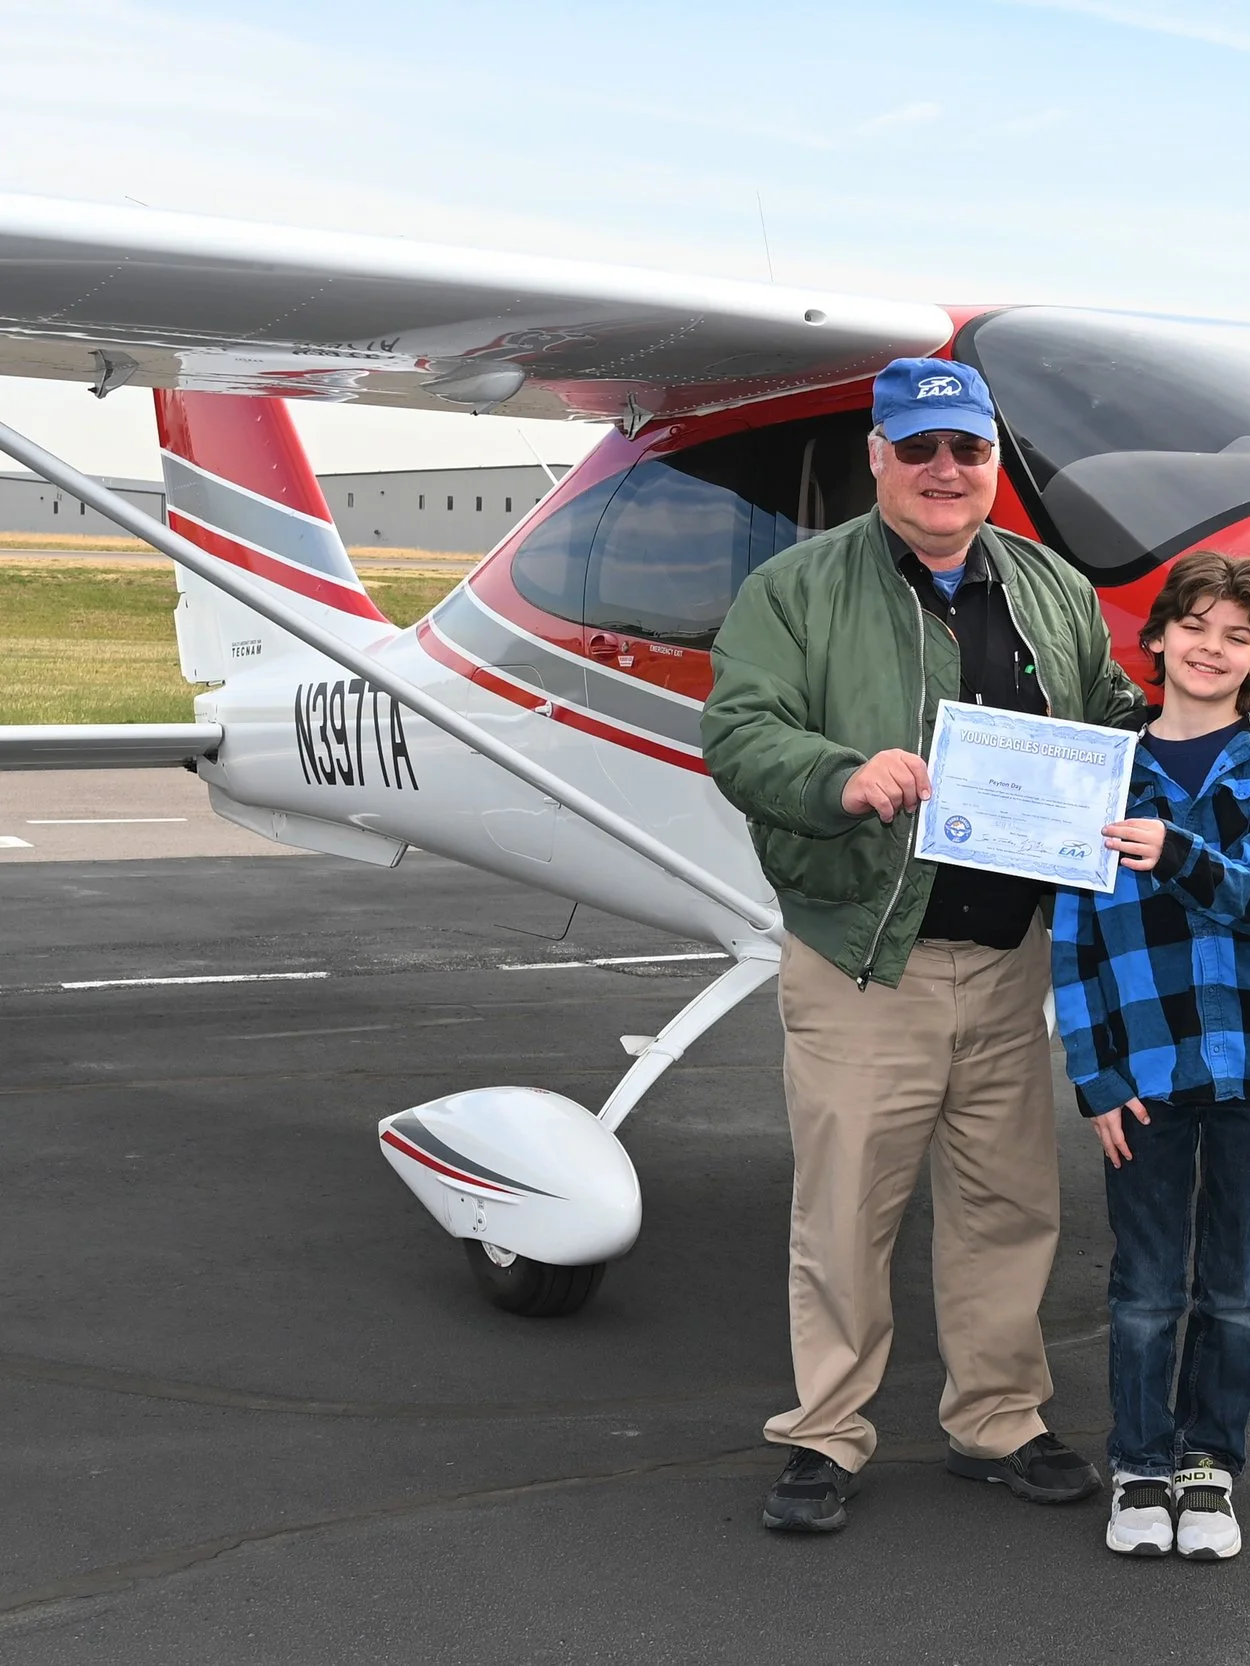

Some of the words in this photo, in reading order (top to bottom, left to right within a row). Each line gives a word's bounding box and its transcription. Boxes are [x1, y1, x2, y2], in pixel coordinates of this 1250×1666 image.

[231, 644, 262, 659] TECNAM
[649, 644, 673, 655] EMERGENCY
[294, 678, 420, 791] N397TA
[960, 729, 998, 748] YOUNG
[999, 735, 1040, 755] EAGLES
[1040, 743, 1107, 766] CERTIFICATE
[988, 778, 1010, 788] Peyton
[1010, 783, 1023, 791] Day
